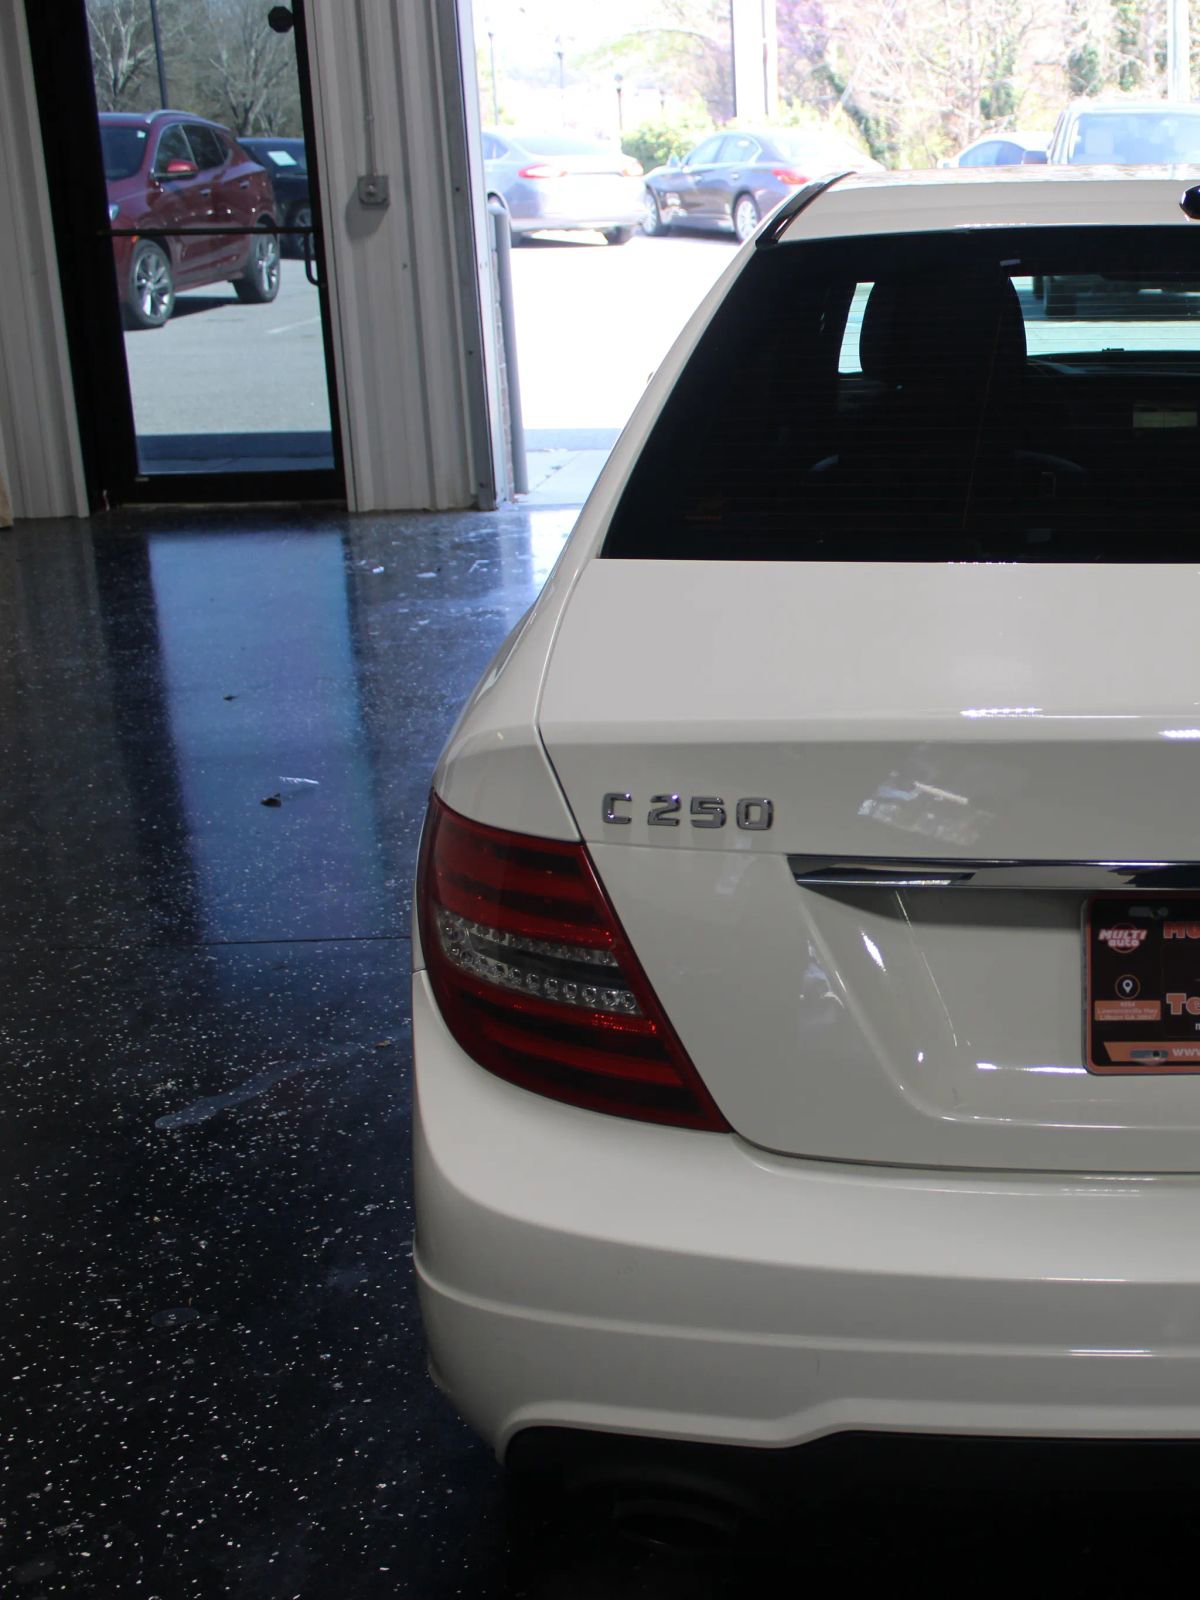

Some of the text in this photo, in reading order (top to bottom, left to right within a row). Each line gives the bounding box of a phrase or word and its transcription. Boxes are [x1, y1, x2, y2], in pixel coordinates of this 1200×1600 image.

[602, 792, 774, 831] C 250
[1098, 929, 1148, 941] MULTI
